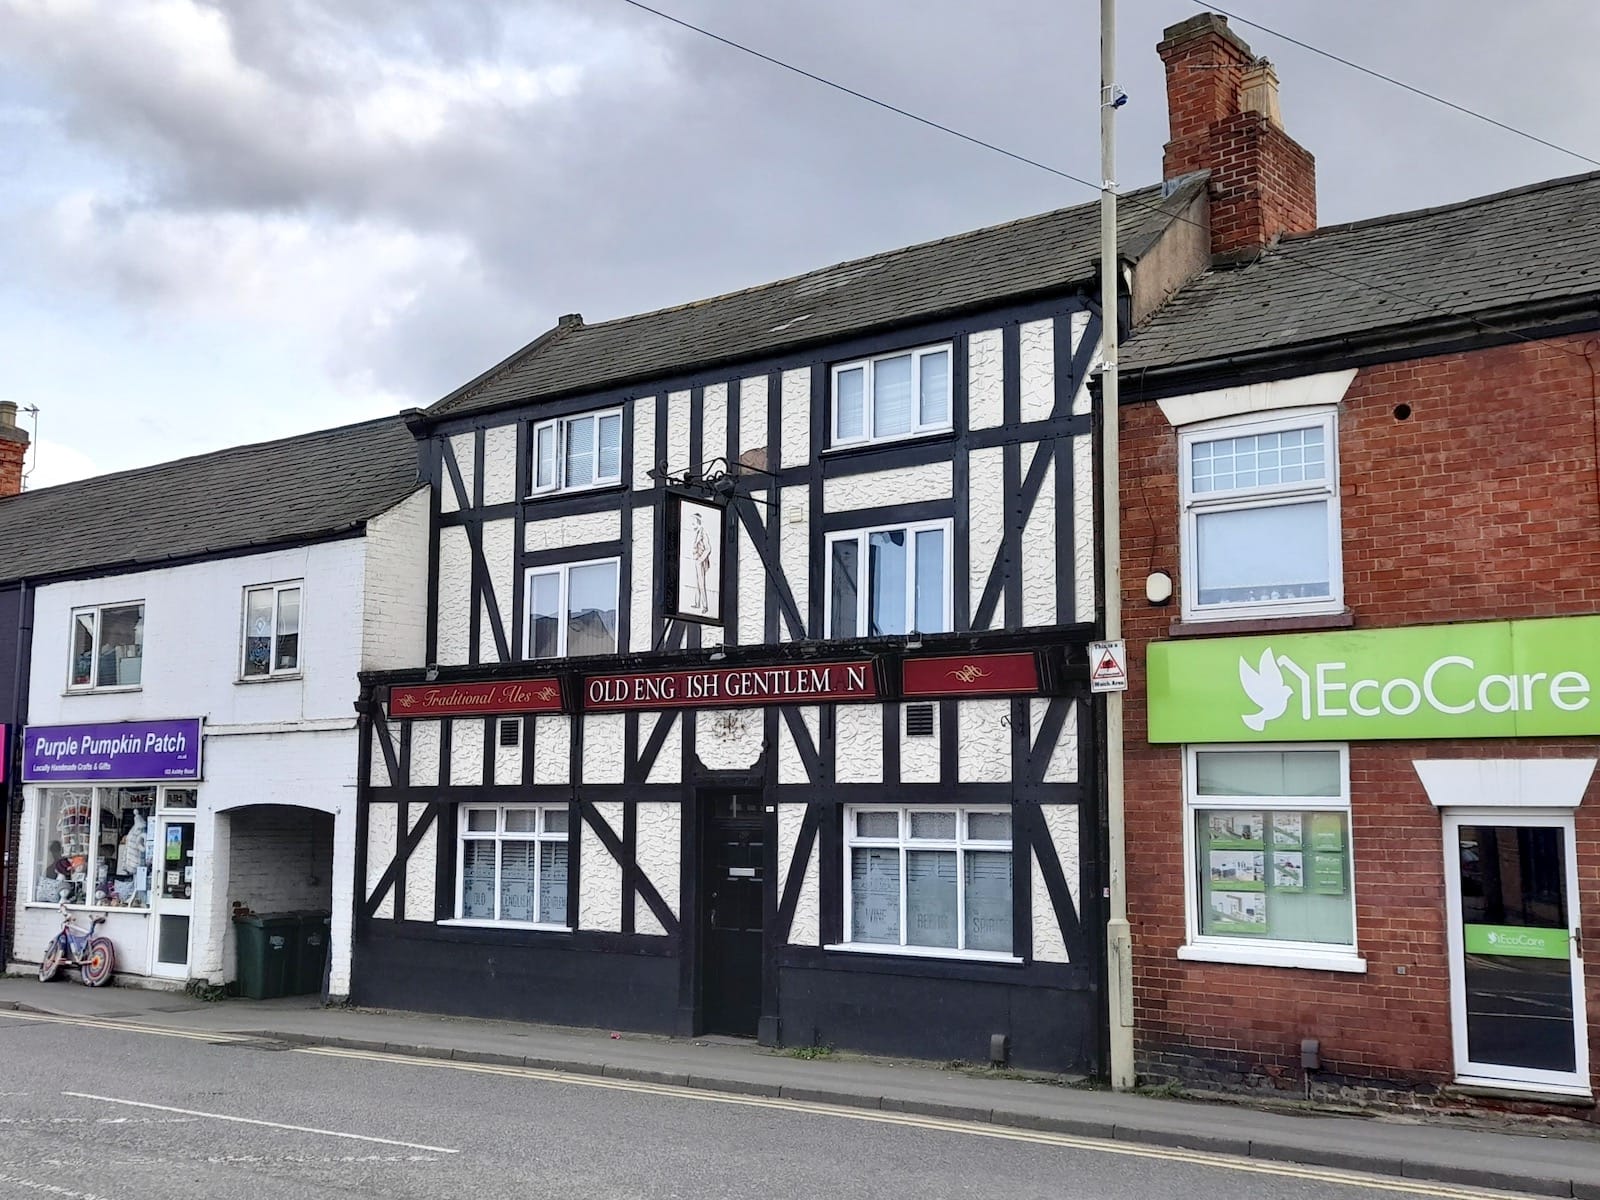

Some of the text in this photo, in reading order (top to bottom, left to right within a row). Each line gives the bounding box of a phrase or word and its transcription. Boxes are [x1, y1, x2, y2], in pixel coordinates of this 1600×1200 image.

[422, 685, 532, 707] Traditional Ales
[590, 679, 629, 702] OLD
[1316, 655, 1591, 718] EcoCare
[35, 731, 186, 760] Purple Pumpkin Patch
[78, 762, 92, 771] Crafts
[98, 762, 111, 770] Gifts
[1500, 933, 1545, 947] EcoCare
